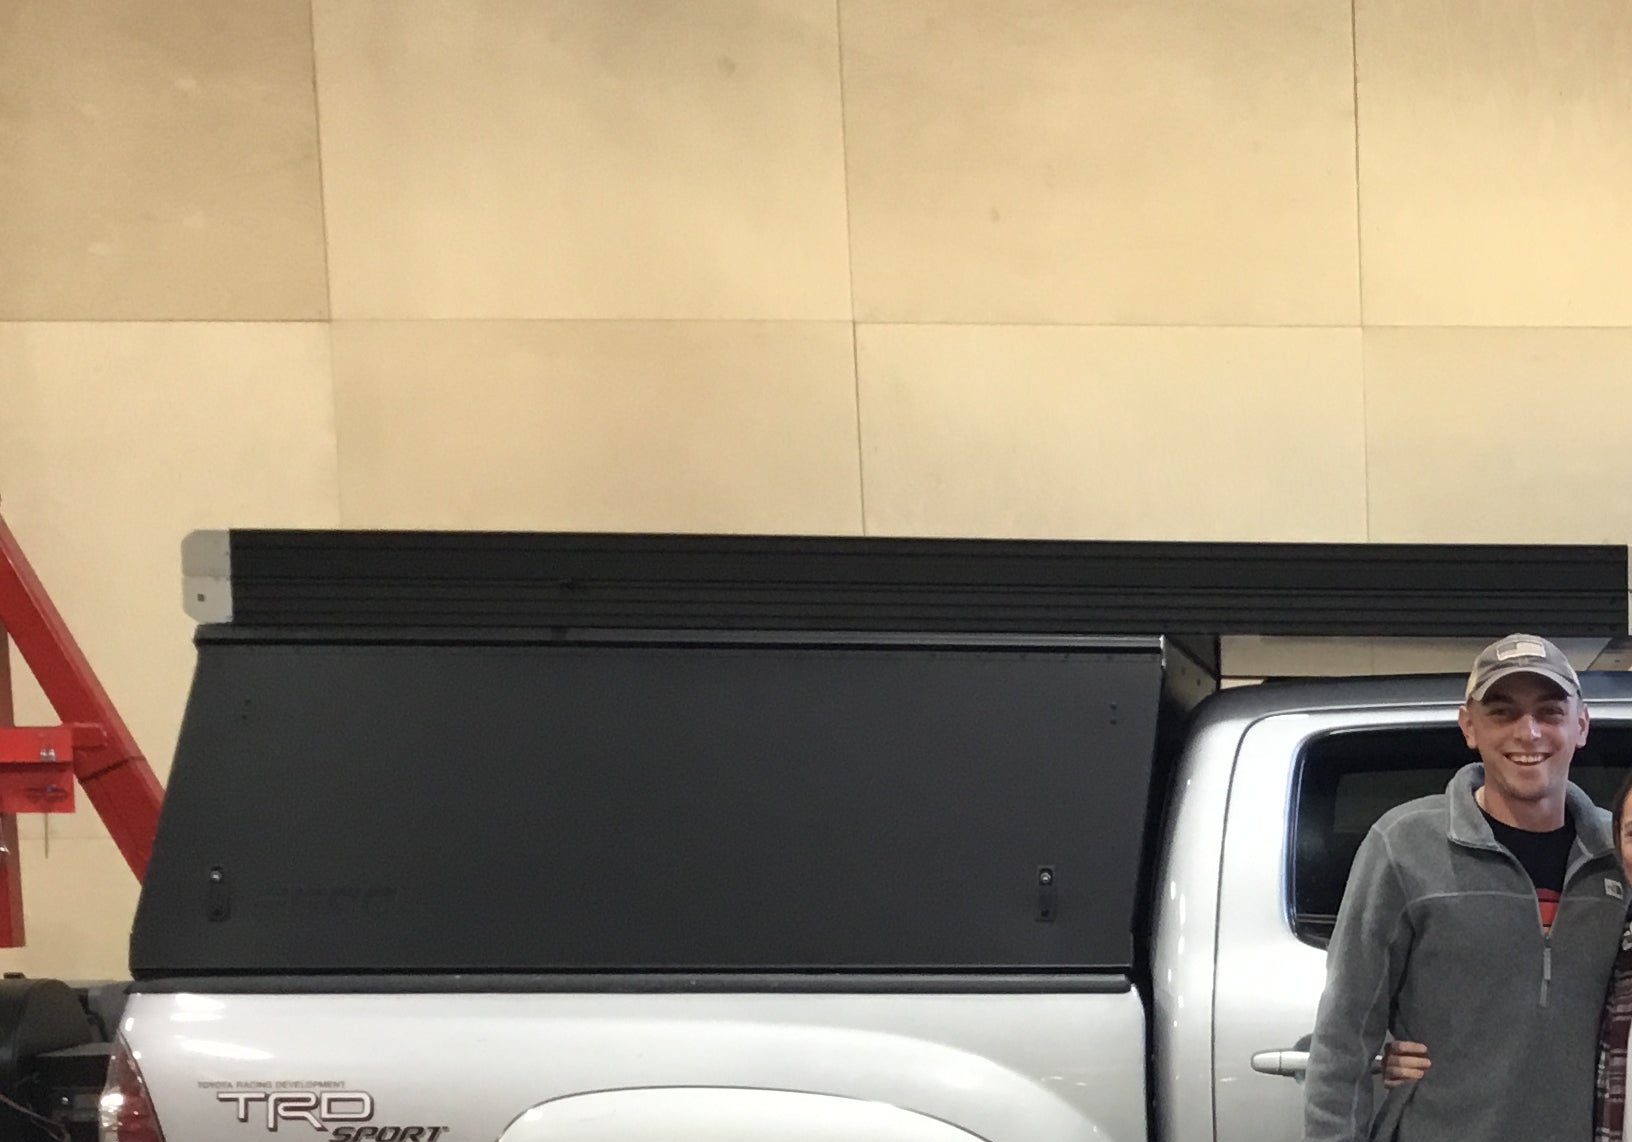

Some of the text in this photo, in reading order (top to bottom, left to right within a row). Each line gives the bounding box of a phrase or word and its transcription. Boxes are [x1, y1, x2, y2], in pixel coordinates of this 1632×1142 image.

[198, 1081, 346, 1089] TOYOTA RACING DEVELOPMENT
[217, 1091, 374, 1132] TRD
